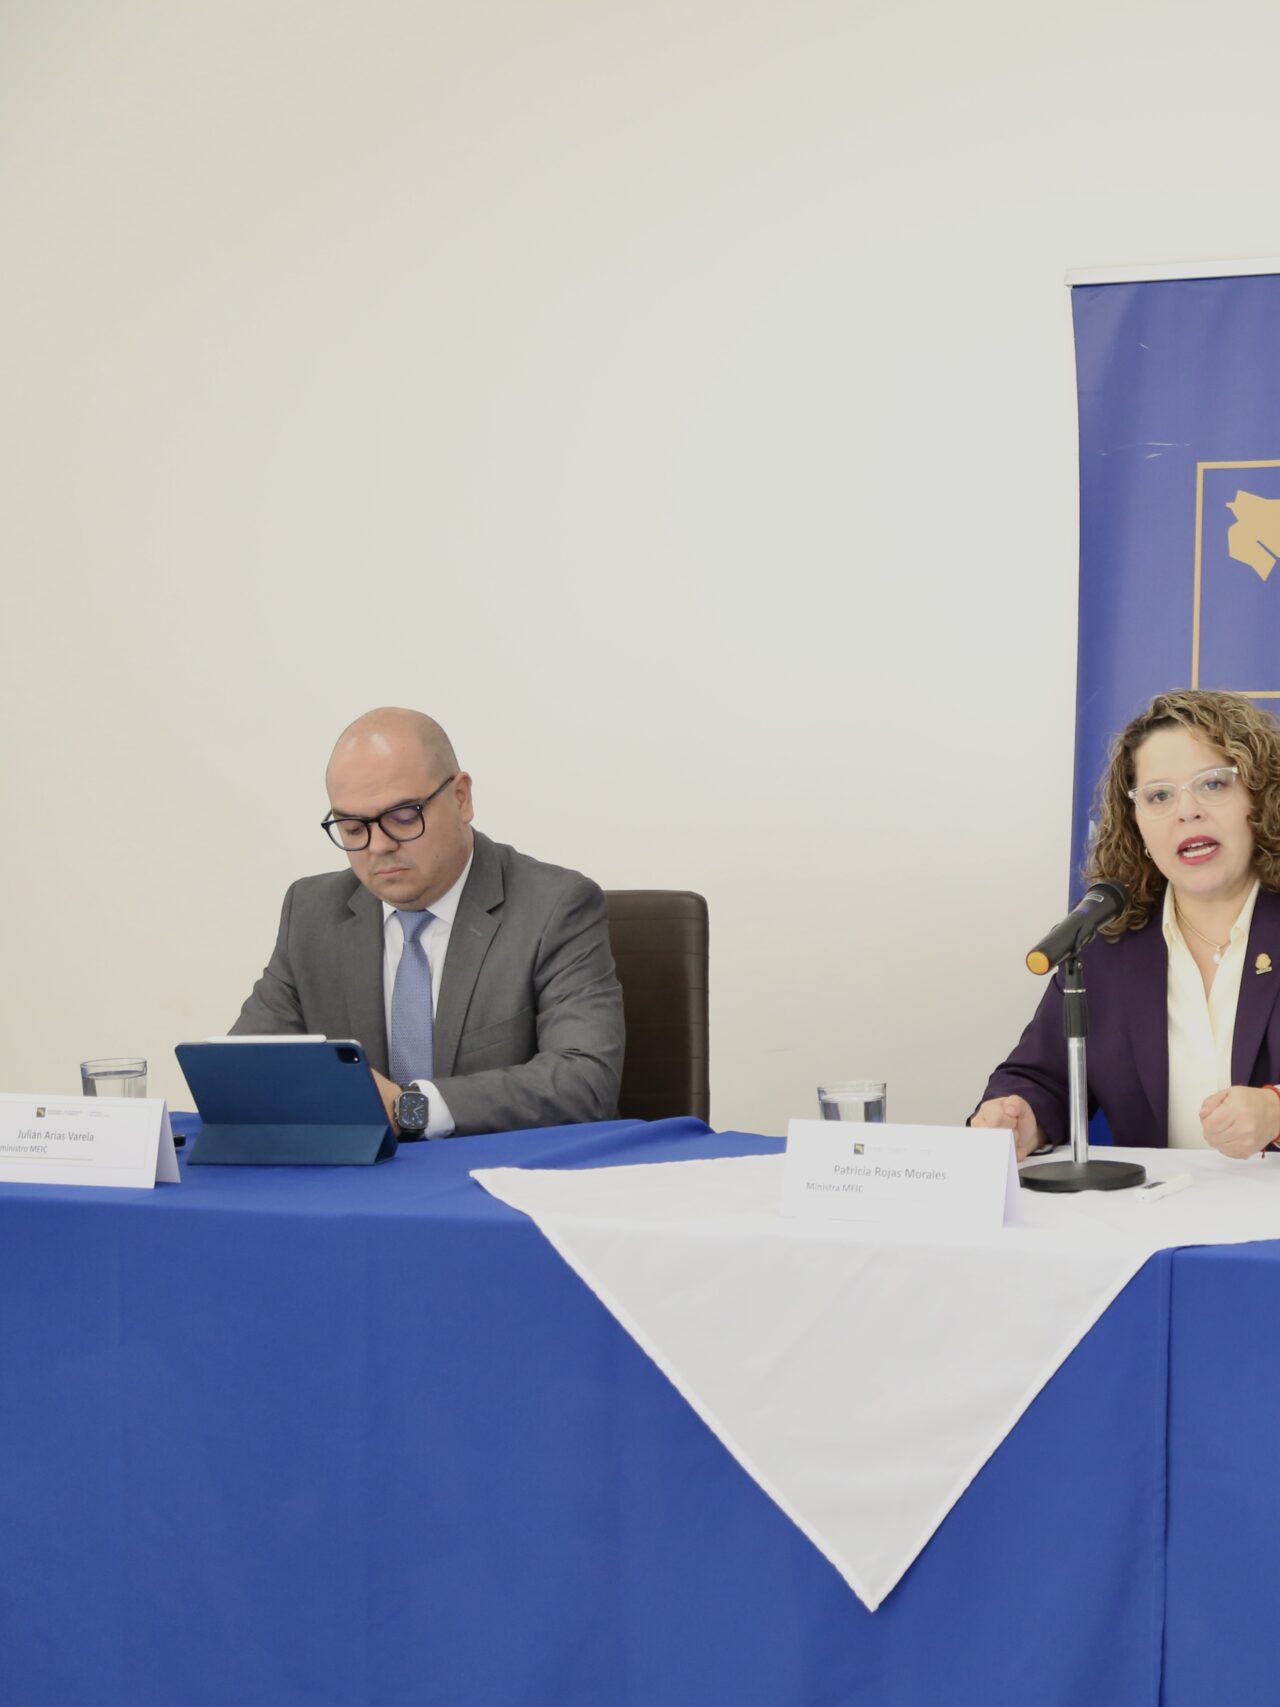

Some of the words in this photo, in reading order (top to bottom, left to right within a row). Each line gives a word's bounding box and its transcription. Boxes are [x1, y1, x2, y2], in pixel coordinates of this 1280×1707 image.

[17, 1128, 42, 1140] Julián
[44, 1130, 65, 1141] Arias
[68, 1131, 95, 1142] Varela
[0, 1144, 28, 1153] ministro
[30, 1145, 48, 1154] MEIC
[833, 1164, 872, 1177] Patricia
[874, 1166, 902, 1180] Rojas
[905, 1168, 947, 1181] Morales
[806, 1182, 840, 1192] Ministra
